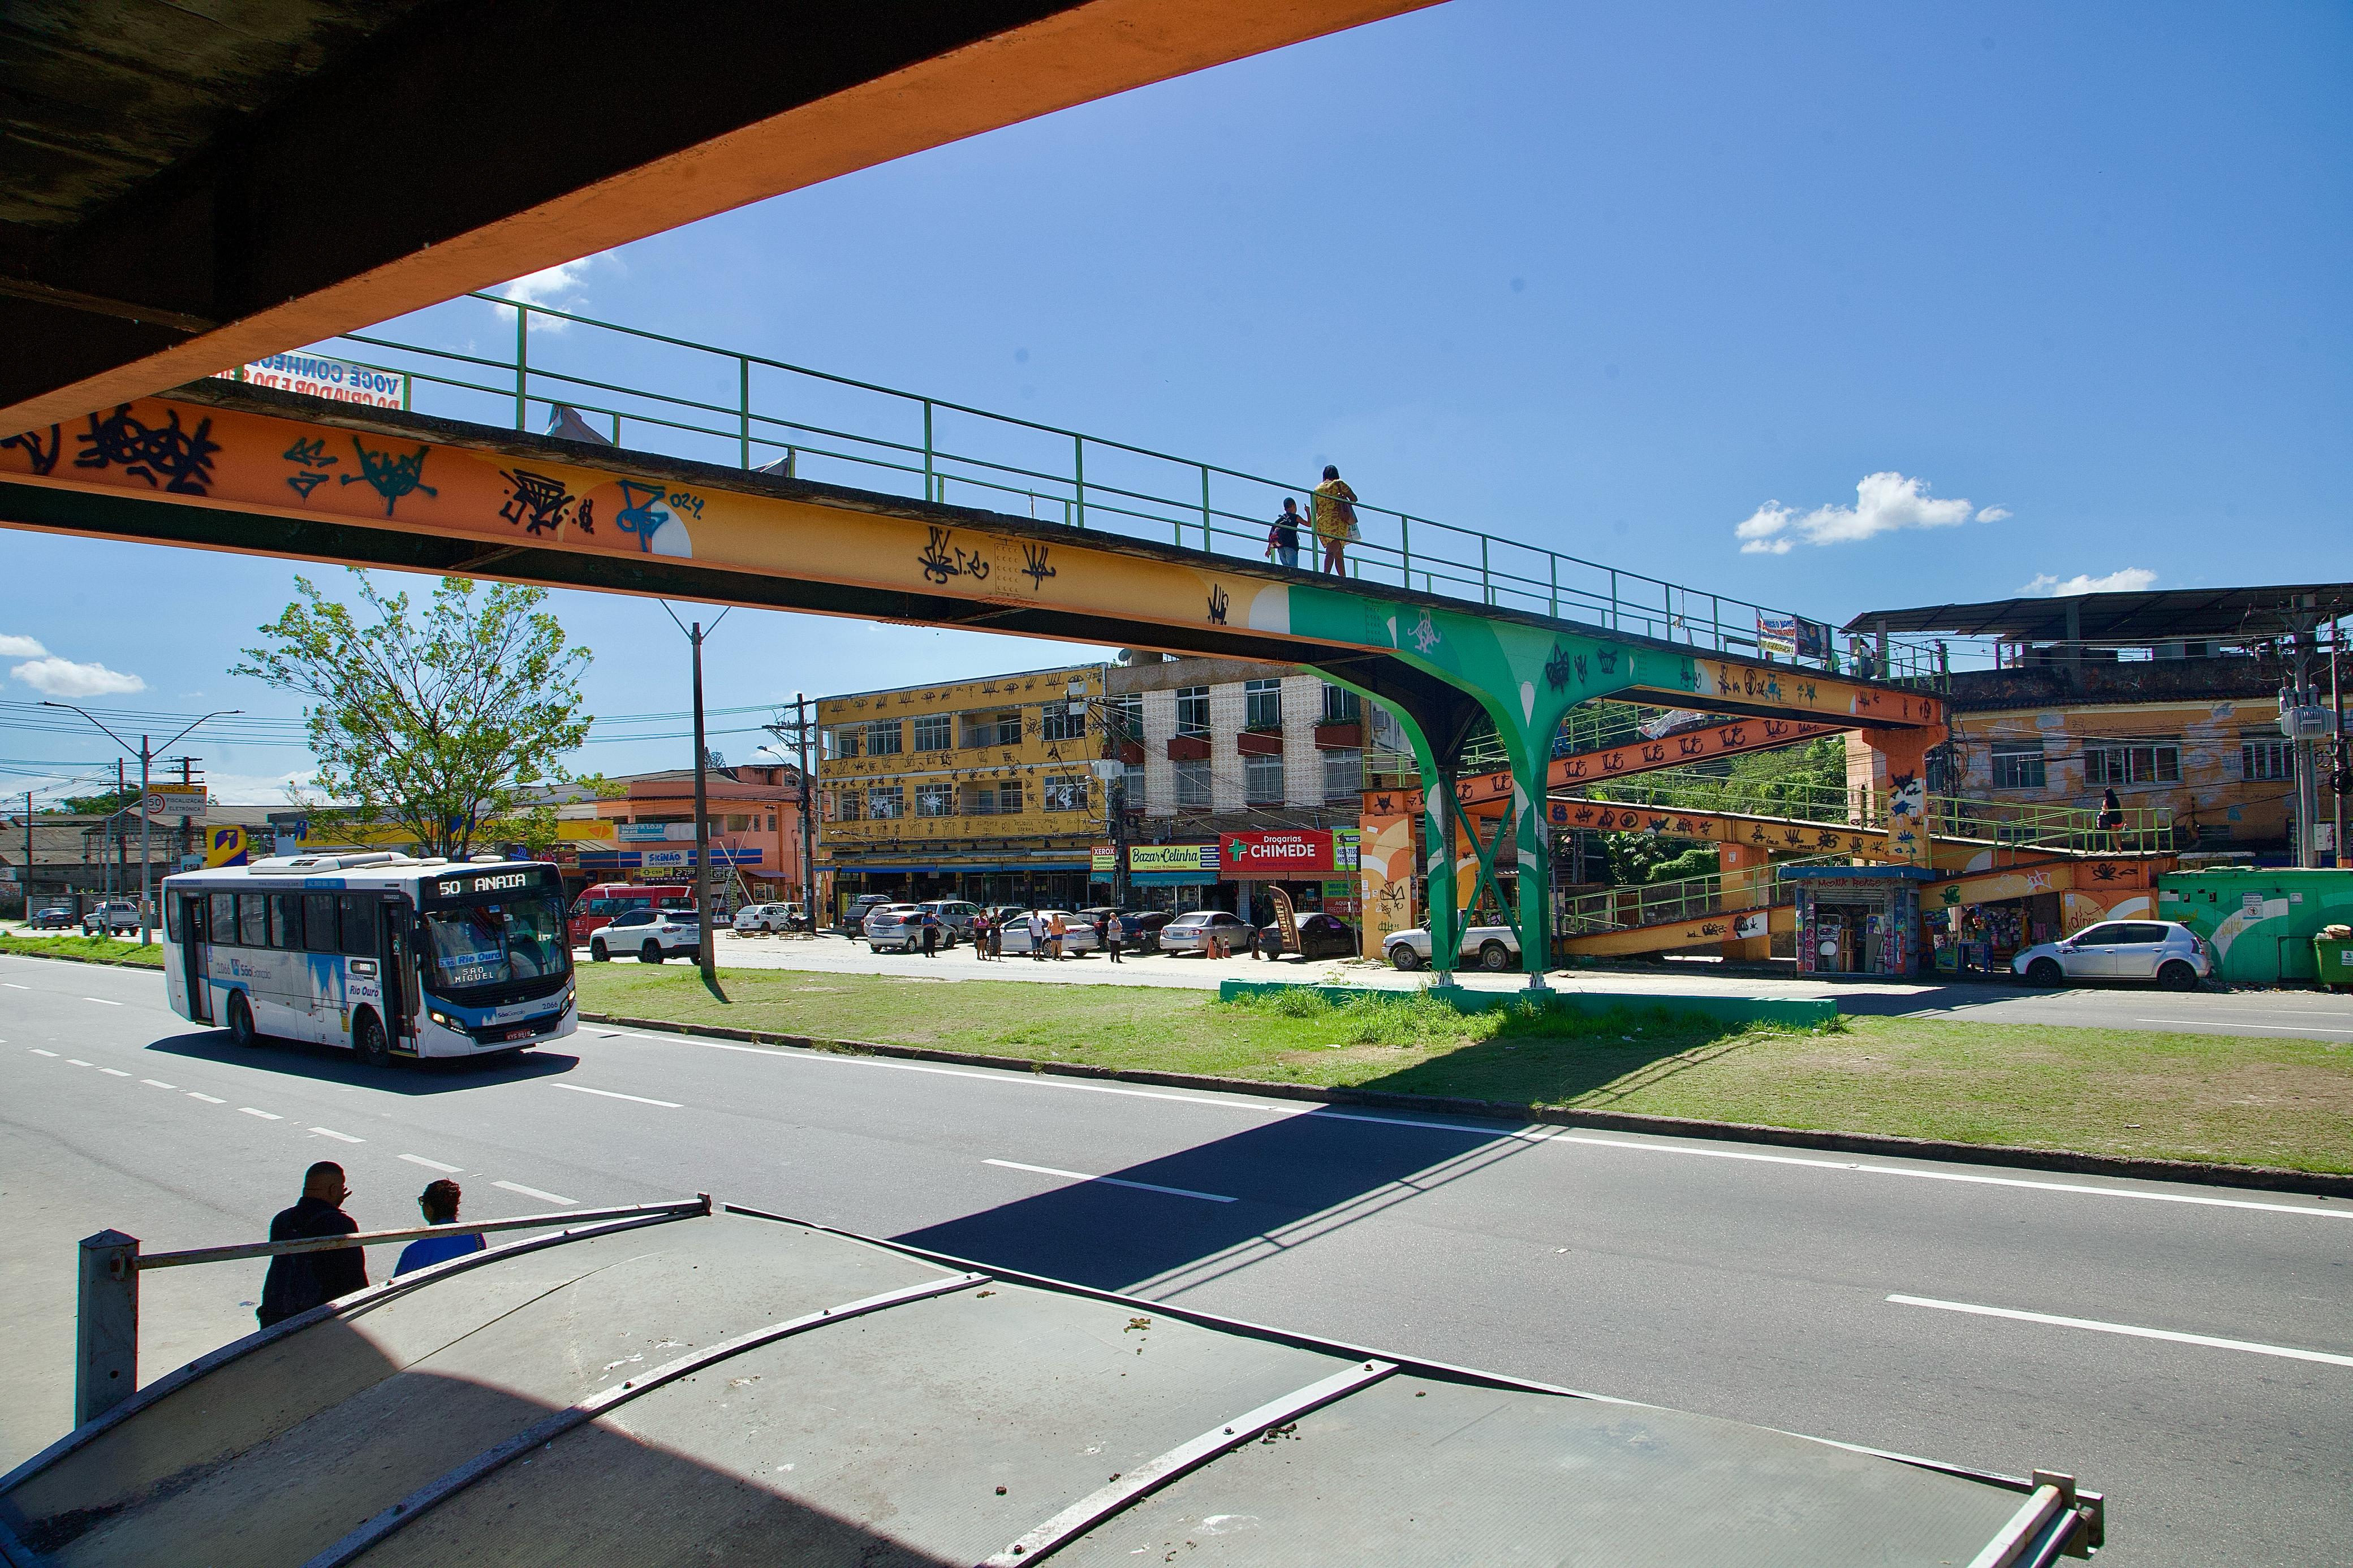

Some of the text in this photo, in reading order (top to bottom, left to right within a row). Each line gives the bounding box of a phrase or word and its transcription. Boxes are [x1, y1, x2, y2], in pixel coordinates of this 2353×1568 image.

[1264, 836, 1302, 844] Drogarias
[1132, 848, 1199, 863] Bazar Celinha
[1251, 844, 1316, 858] CHIMEDE
[439, 873, 526, 896] 50 ANAIA
[458, 954, 475, 965] Rio
[477, 952, 502, 961] Ouro
[455, 971, 494, 983] MIGUEL
[348, 984, 379, 997] Rio Ouro
